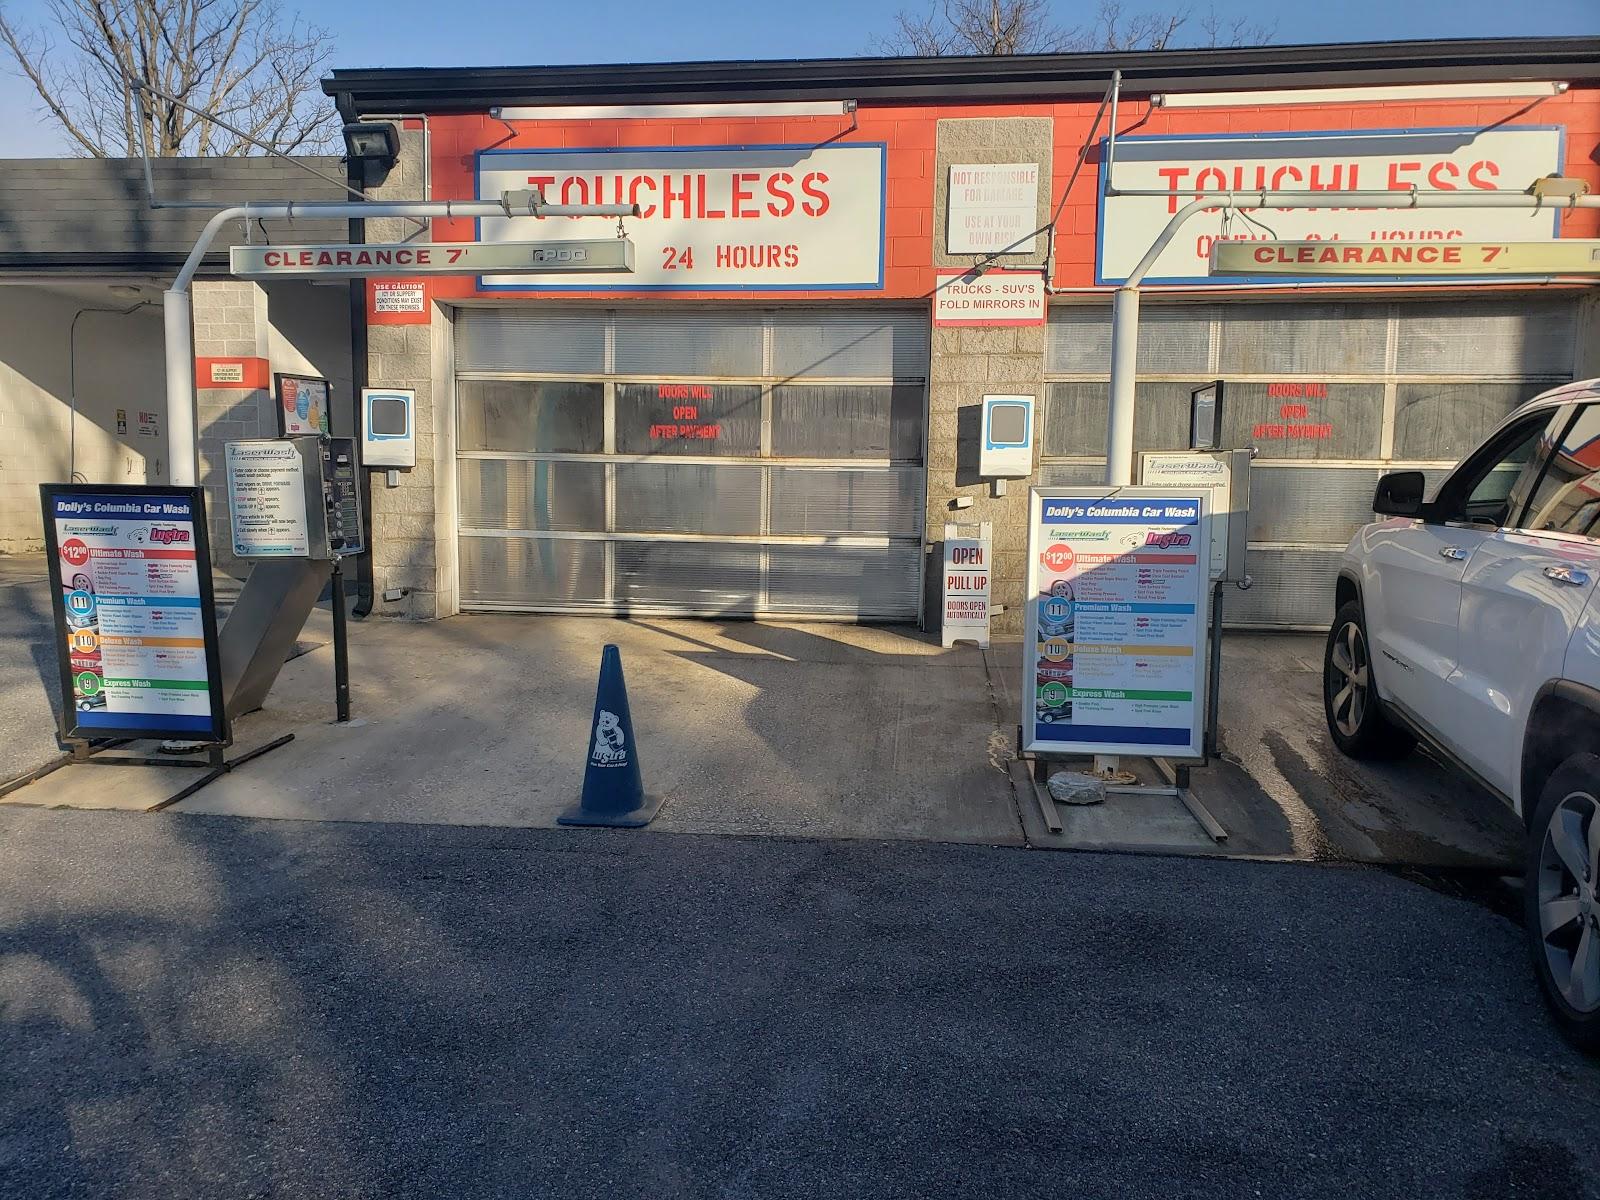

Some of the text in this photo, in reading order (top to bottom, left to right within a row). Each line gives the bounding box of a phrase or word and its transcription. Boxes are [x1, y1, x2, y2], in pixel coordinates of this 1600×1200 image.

[953, 171, 1036, 185] NOT RESPONSIBLE
[527, 172, 830, 220] TOUCHLESS
[965, 215, 981, 228] USE
[264, 249, 468, 267] CLEARANCE 7'
[662, 244, 799, 269] 24 HOURS
[1254, 246, 1461, 263] CLEARANCE
[1481, 246, 1508, 262] 7'
[946, 285, 992, 294] TRUCKS
[1002, 284, 1035, 294] SUV'S
[940, 300, 1040, 309] FOLD MIRRORS IN
[658, 385, 689, 398] DOORS
[1268, 384, 1302, 397] DOORS
[673, 406, 697, 419] OPEN
[649, 425, 678, 438] AFTER
[57, 501, 190, 514] Dolly's Columbia Car Wash
[1046, 506, 1195, 517] Dolly's Columbia Car Wash
[90, 549, 145, 558] Ultimate Wash
[952, 548, 983, 564] OPEN
[1076, 554, 1137, 563] Ultimate Wash
[947, 576, 987, 590] PULL UP
[74, 597, 87, 608] 11
[96, 597, 146, 606] Premium Wash
[947, 601, 986, 611] DOORS OPEN
[1074, 603, 1132, 612] Premium Wash
[946, 611, 987, 620] AUTOMATICALLY
[104, 680, 151, 689] Express Wash
[1072, 690, 1125, 699] Express Wash
